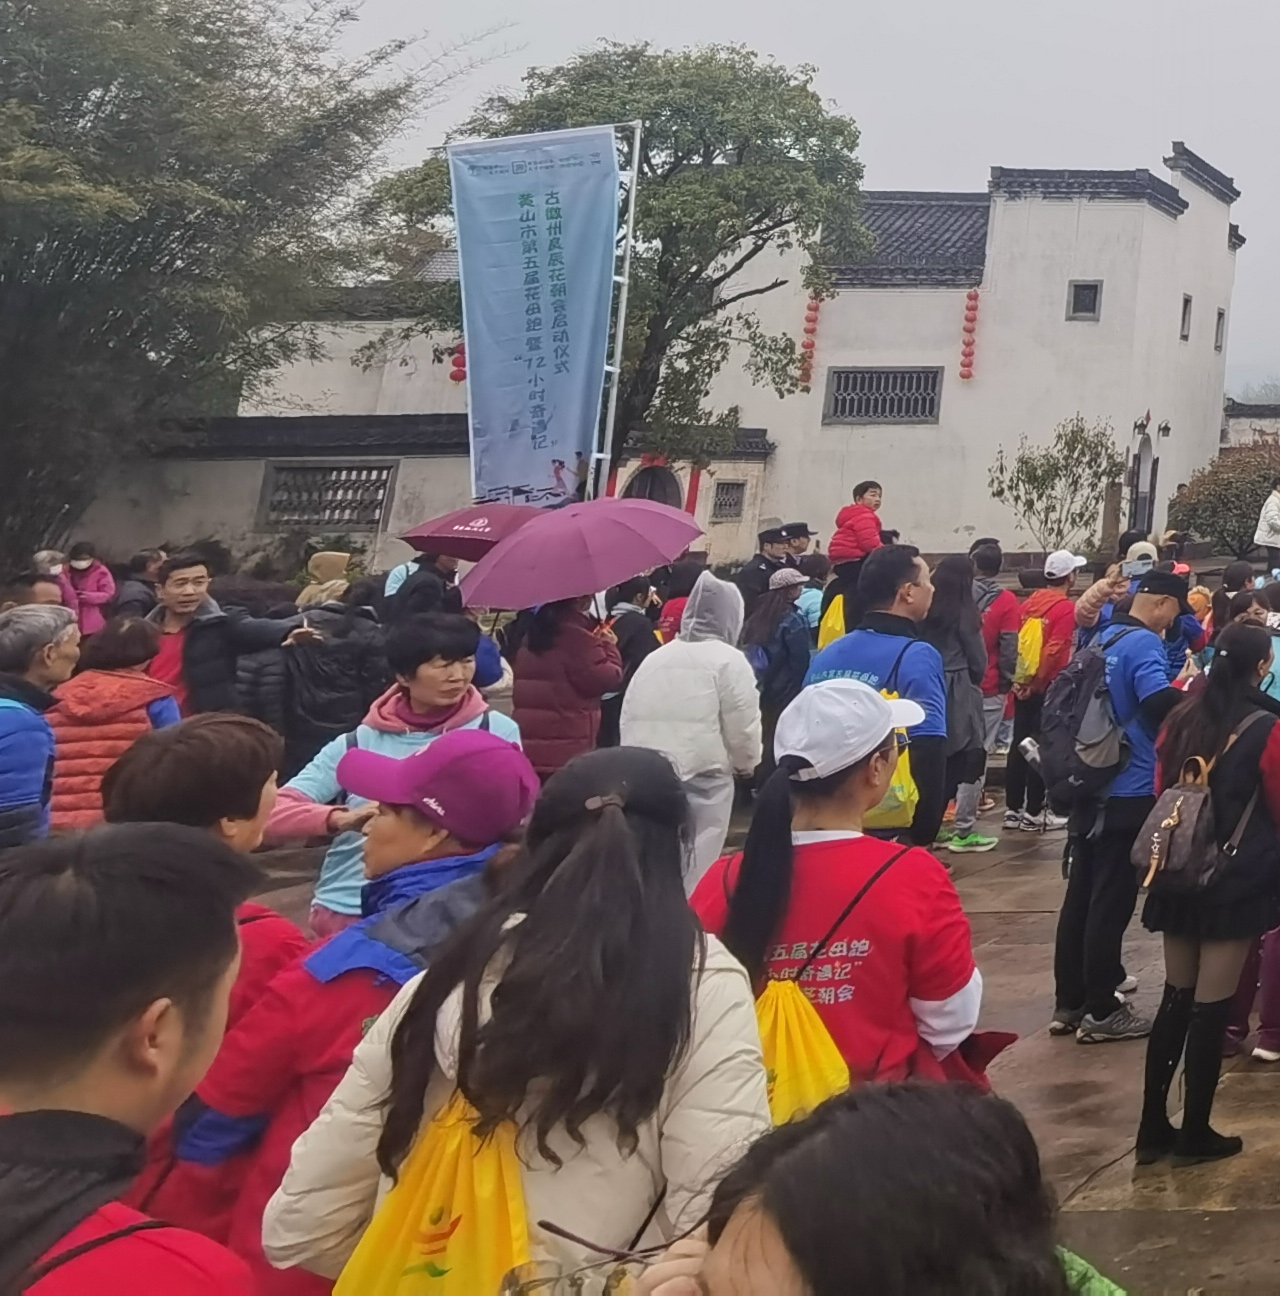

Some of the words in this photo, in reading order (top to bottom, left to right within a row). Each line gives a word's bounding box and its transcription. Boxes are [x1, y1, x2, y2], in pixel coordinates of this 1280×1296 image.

[545, 190, 570, 375] 古徽州良辰花朝会启动仪式
